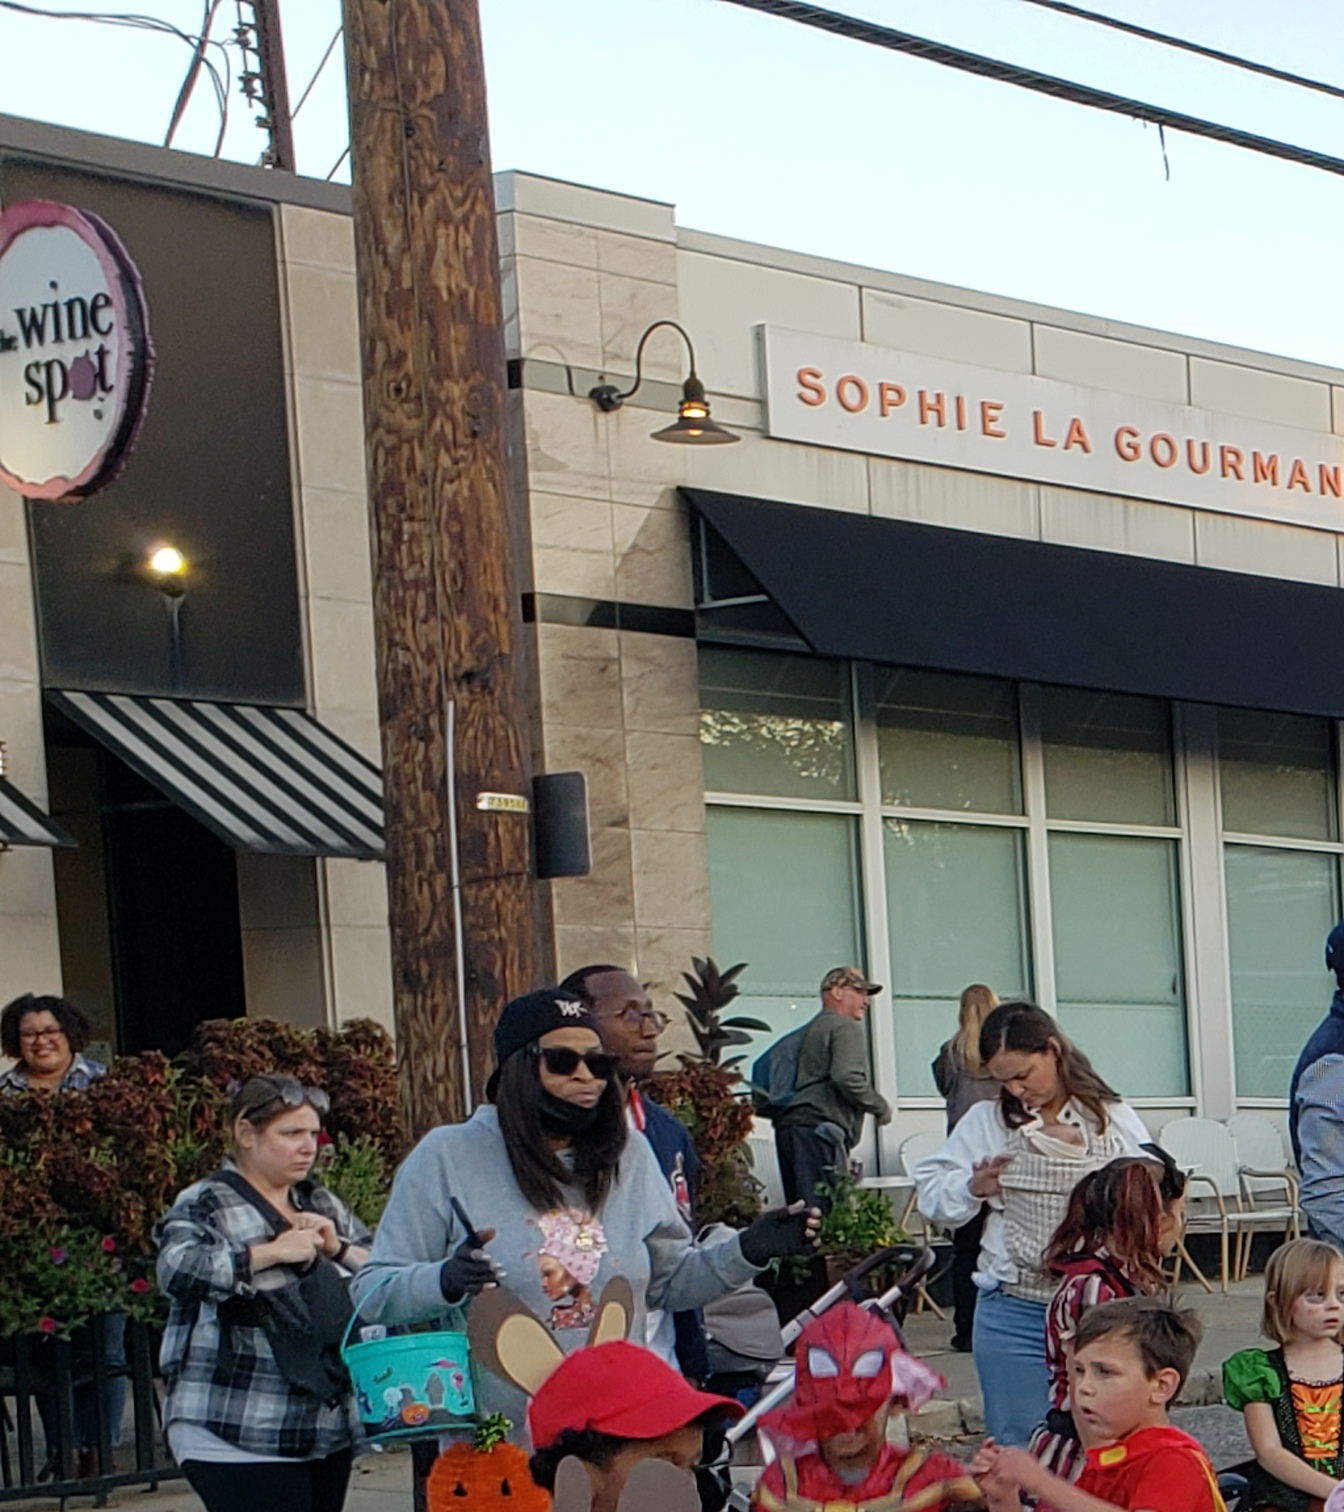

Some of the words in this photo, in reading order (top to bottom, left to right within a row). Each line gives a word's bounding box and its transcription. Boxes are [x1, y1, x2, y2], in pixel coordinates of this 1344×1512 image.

[13, 280, 114, 349] wine
[24, 343, 115, 425] spot
[797, 367, 1007, 438] SOPHIE
[1033, 410, 1092, 454] LA
